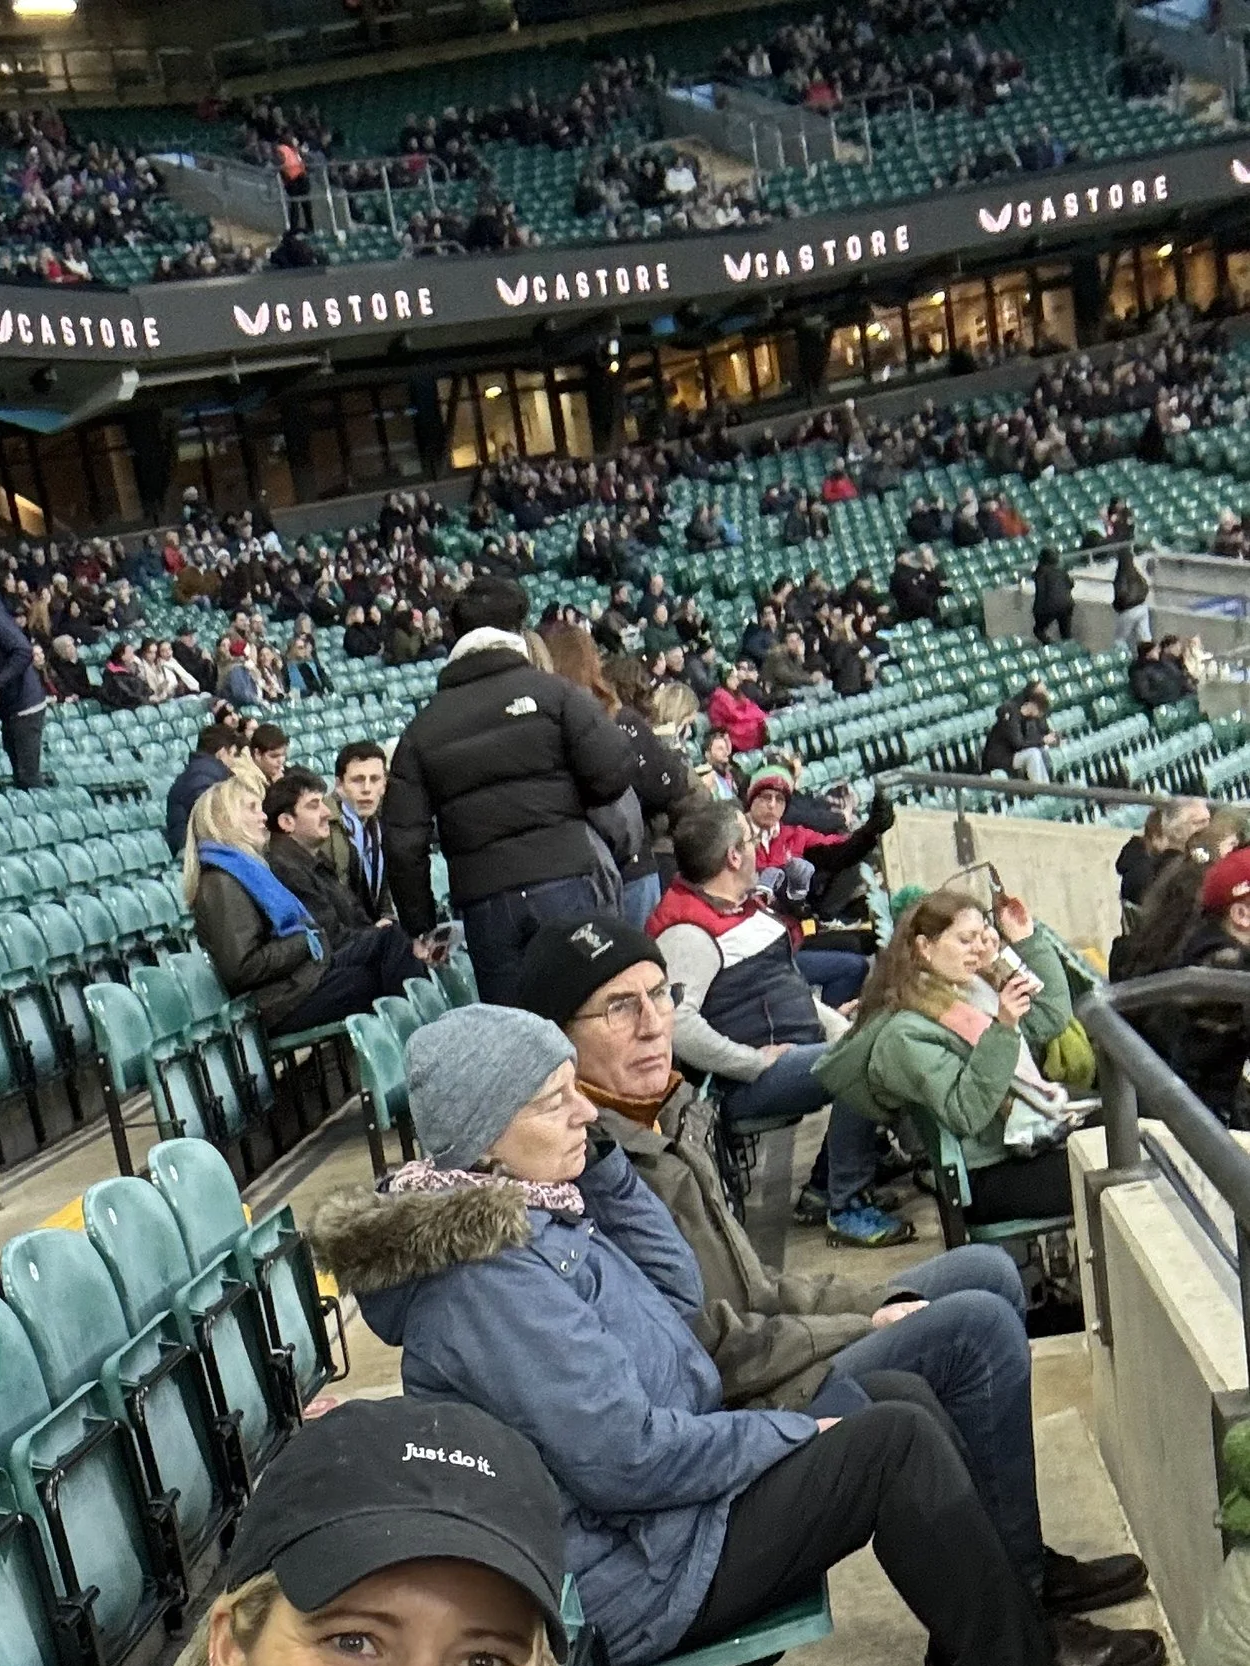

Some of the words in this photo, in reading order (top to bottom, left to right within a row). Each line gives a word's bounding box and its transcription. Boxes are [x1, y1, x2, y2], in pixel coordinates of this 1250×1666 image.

[1016, 174, 1168, 228] CASTORE
[754, 224, 910, 278] CASTORE
[532, 262, 670, 303] CASTORE
[16, 312, 161, 349] CASTORE
[275, 287, 434, 333] CASTORE
[401, 1442, 447, 1462] Just
[448, 1450, 475, 1467] do
[477, 1455, 496, 1477] it.
